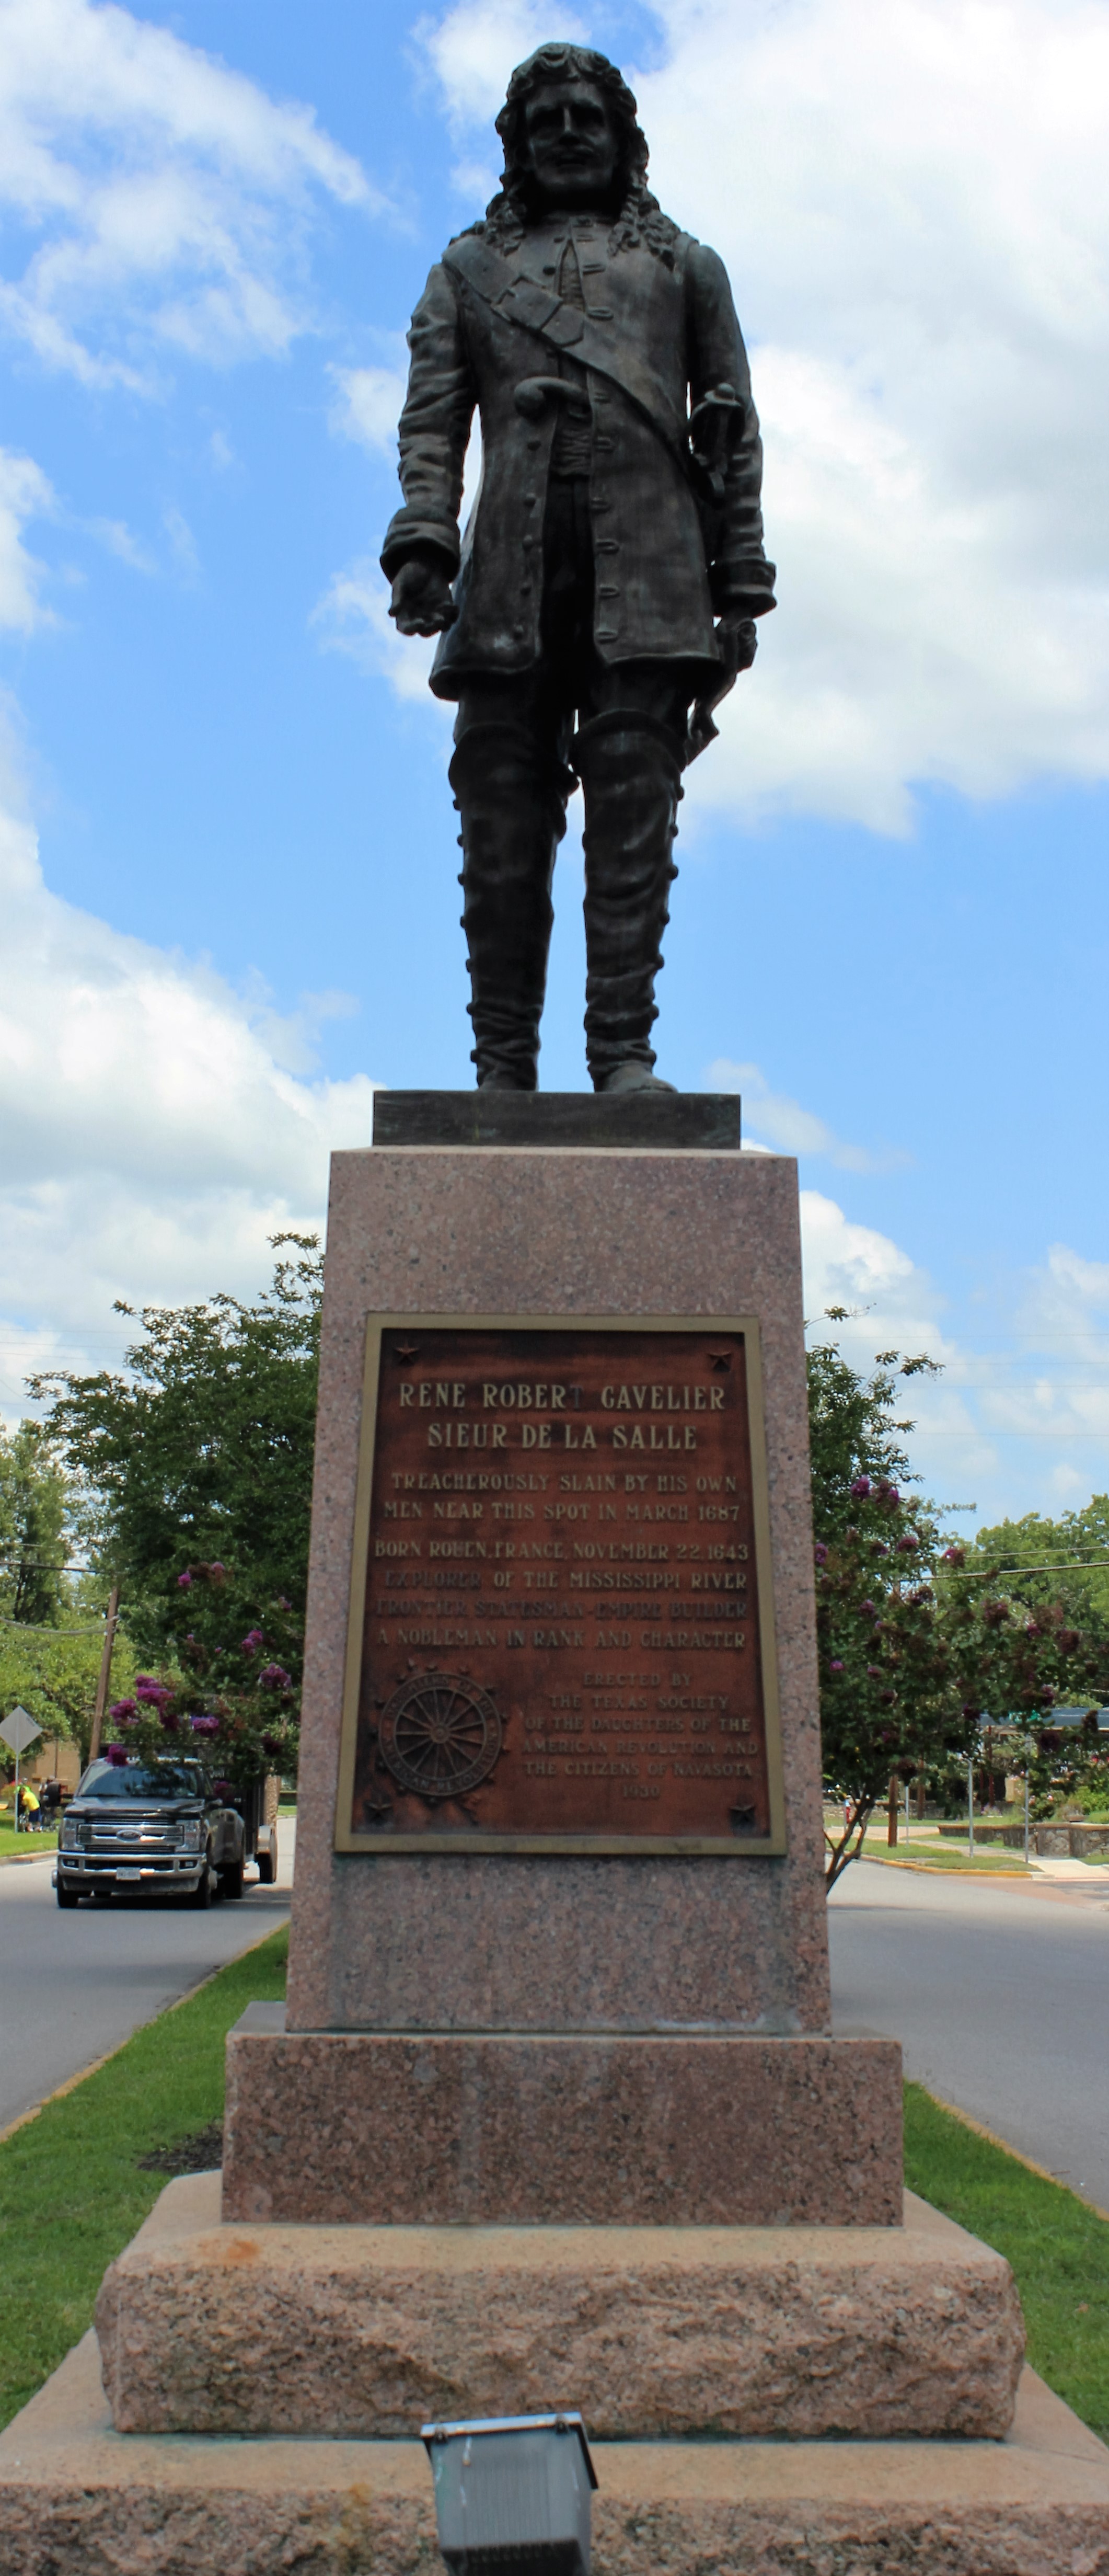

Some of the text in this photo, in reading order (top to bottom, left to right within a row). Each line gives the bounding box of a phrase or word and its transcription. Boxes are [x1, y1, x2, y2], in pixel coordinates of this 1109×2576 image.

[399, 1383, 466, 1408] RENE
[483, 1384, 584, 1409] ROBERT
[428, 1423, 697, 1450] SIEUR DE LA SALLE
[391, 1472, 737, 1492] TREACHEROUSLY SLAIN BY HIS OWN
[384, 1501, 740, 1522] MEN NEAR THIS SPOT IN MARCH 1687
[375, 1540, 422, 1558] BORN
[573, 1542, 669, 1560] NOVEMBER
[707, 1543, 749, 1561] 1643
[385, 1571, 747, 1589] EXPLORER OF THE MISSISSIPPI RIVER
[377, 1600, 468, 1617] FRONTIER
[672, 1602, 747, 1620] BUILDER
[377, 1629, 747, 1648] A NOBLEMAN IN RANK AND CHARACTER
[584, 1673, 692, 1686] ERECTED BY
[550, 1695, 730, 1709] THE TEXAS SOCIETY
[525, 1718, 751, 1732] OF THE DAUGHTERS OF THE
[522, 1741, 758, 1754] AMERICAN REVOLUTION AND
[525, 1762, 753, 1776] THE CITIZENS OF NAVASOTA
